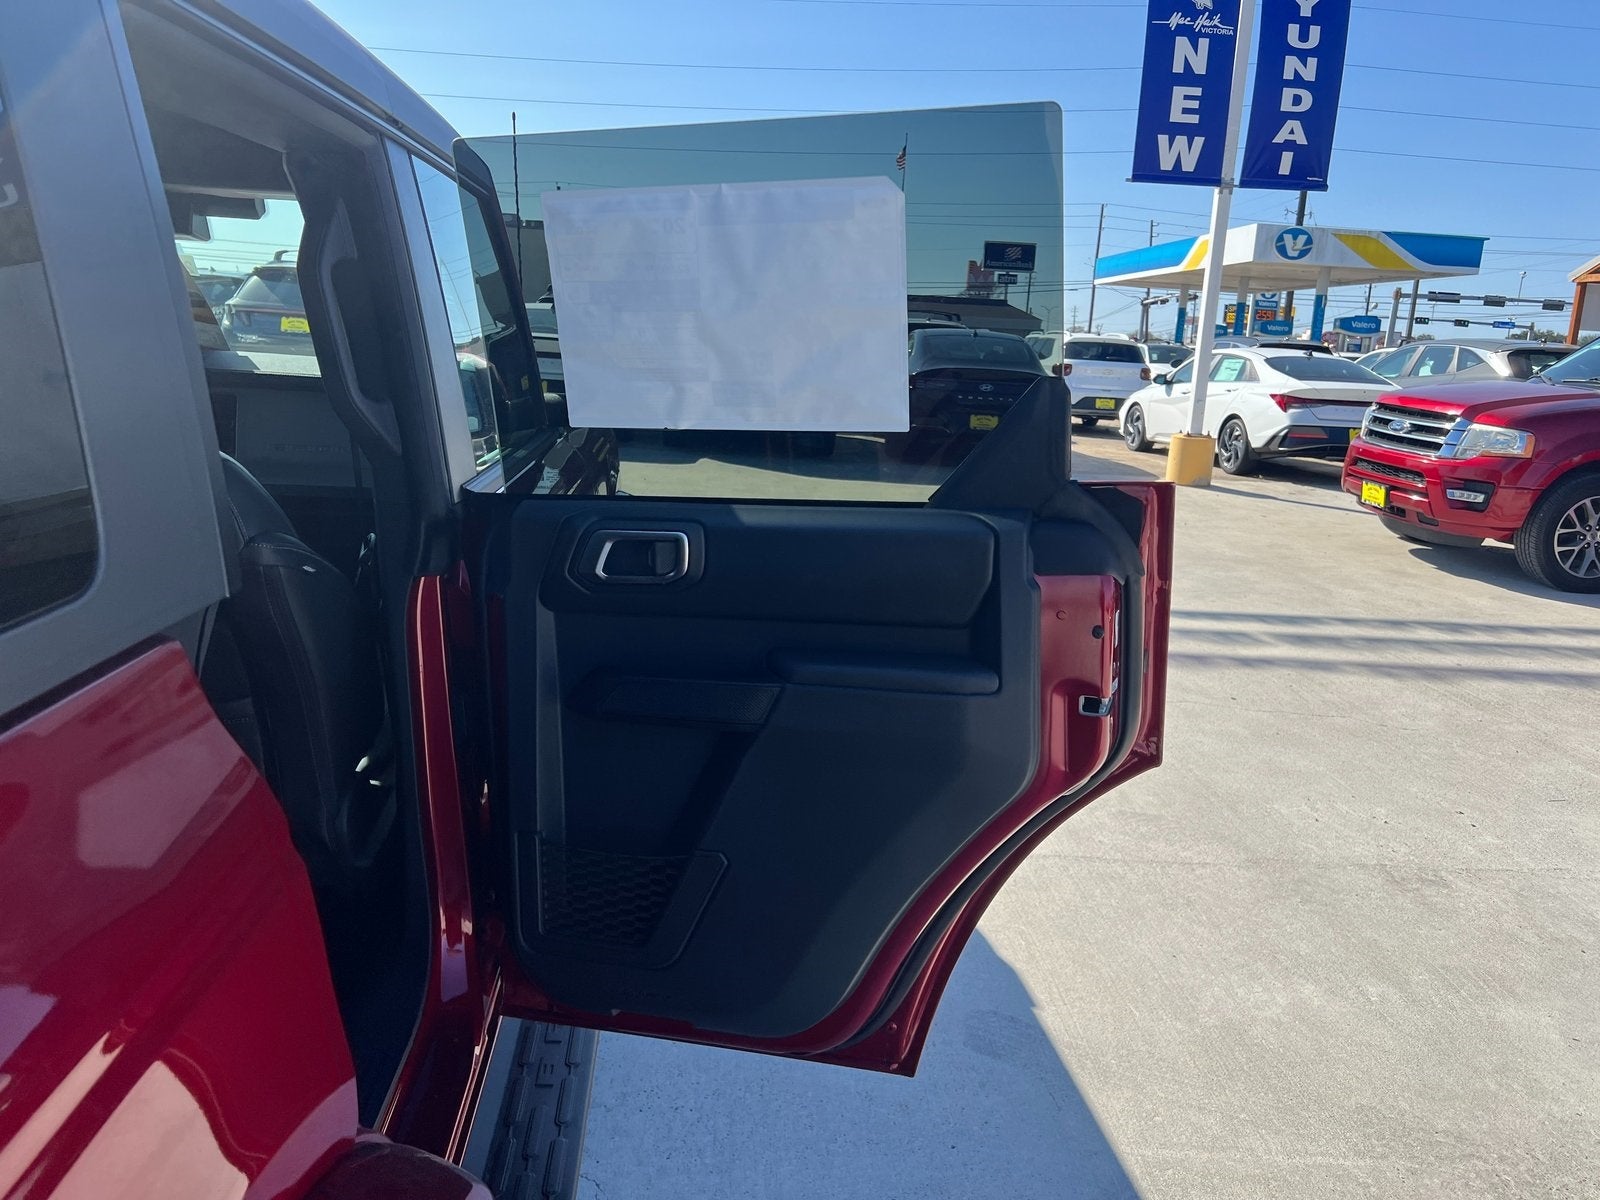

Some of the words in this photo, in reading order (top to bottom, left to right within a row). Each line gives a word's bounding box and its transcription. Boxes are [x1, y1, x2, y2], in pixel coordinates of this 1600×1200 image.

[1152, 11, 1194, 31] Mac
[1193, 11, 1233, 32] Haik
[1201, 27, 1234, 36] VICTORIA
[1157, 36, 1210, 173] NEW
[1266, 324, 1289, 332] Valero
[1351, 320, 1376, 329] Valero
